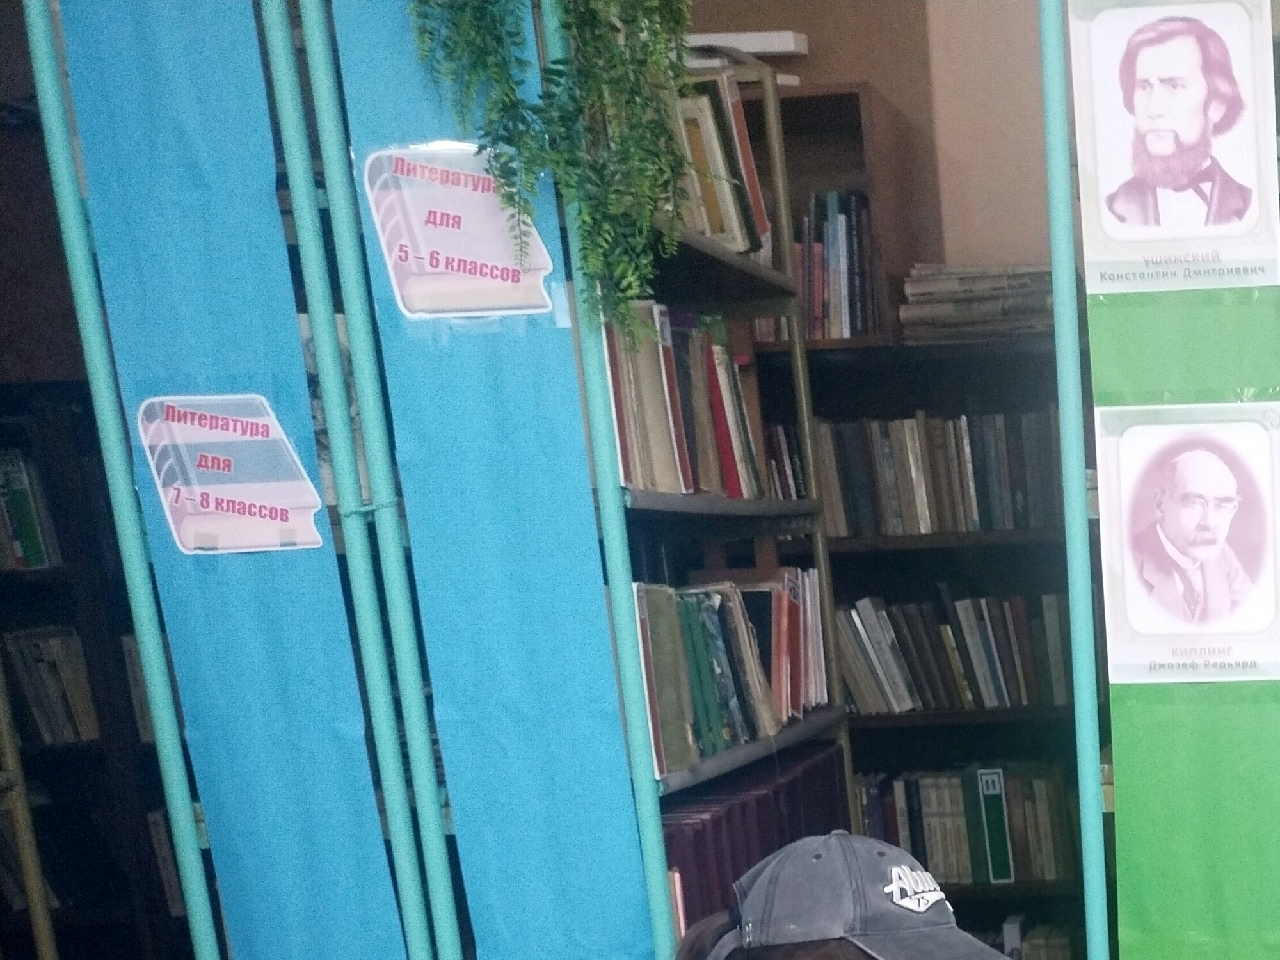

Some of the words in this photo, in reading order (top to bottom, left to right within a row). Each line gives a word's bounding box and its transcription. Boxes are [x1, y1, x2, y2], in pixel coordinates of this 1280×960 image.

[424, 209, 462, 230] для
[398, 243, 409, 263] 5
[429, 250, 440, 269] 6
[445, 255, 521, 284] классов
[1100, 269, 1177, 282] Константин
[1183, 264, 1266, 279] Дмитриевич
[164, 403, 270, 439] Литература
[196, 453, 232, 473] для
[172, 487, 181, 505] 7
[200, 491, 210, 509] 8
[215, 496, 290, 523] классов
[1171, 646, 1233, 657] КИПЛИНГ
[1149, 660, 1199, 671] Джозеф
[1204, 660, 1258, 670] Редьярд
